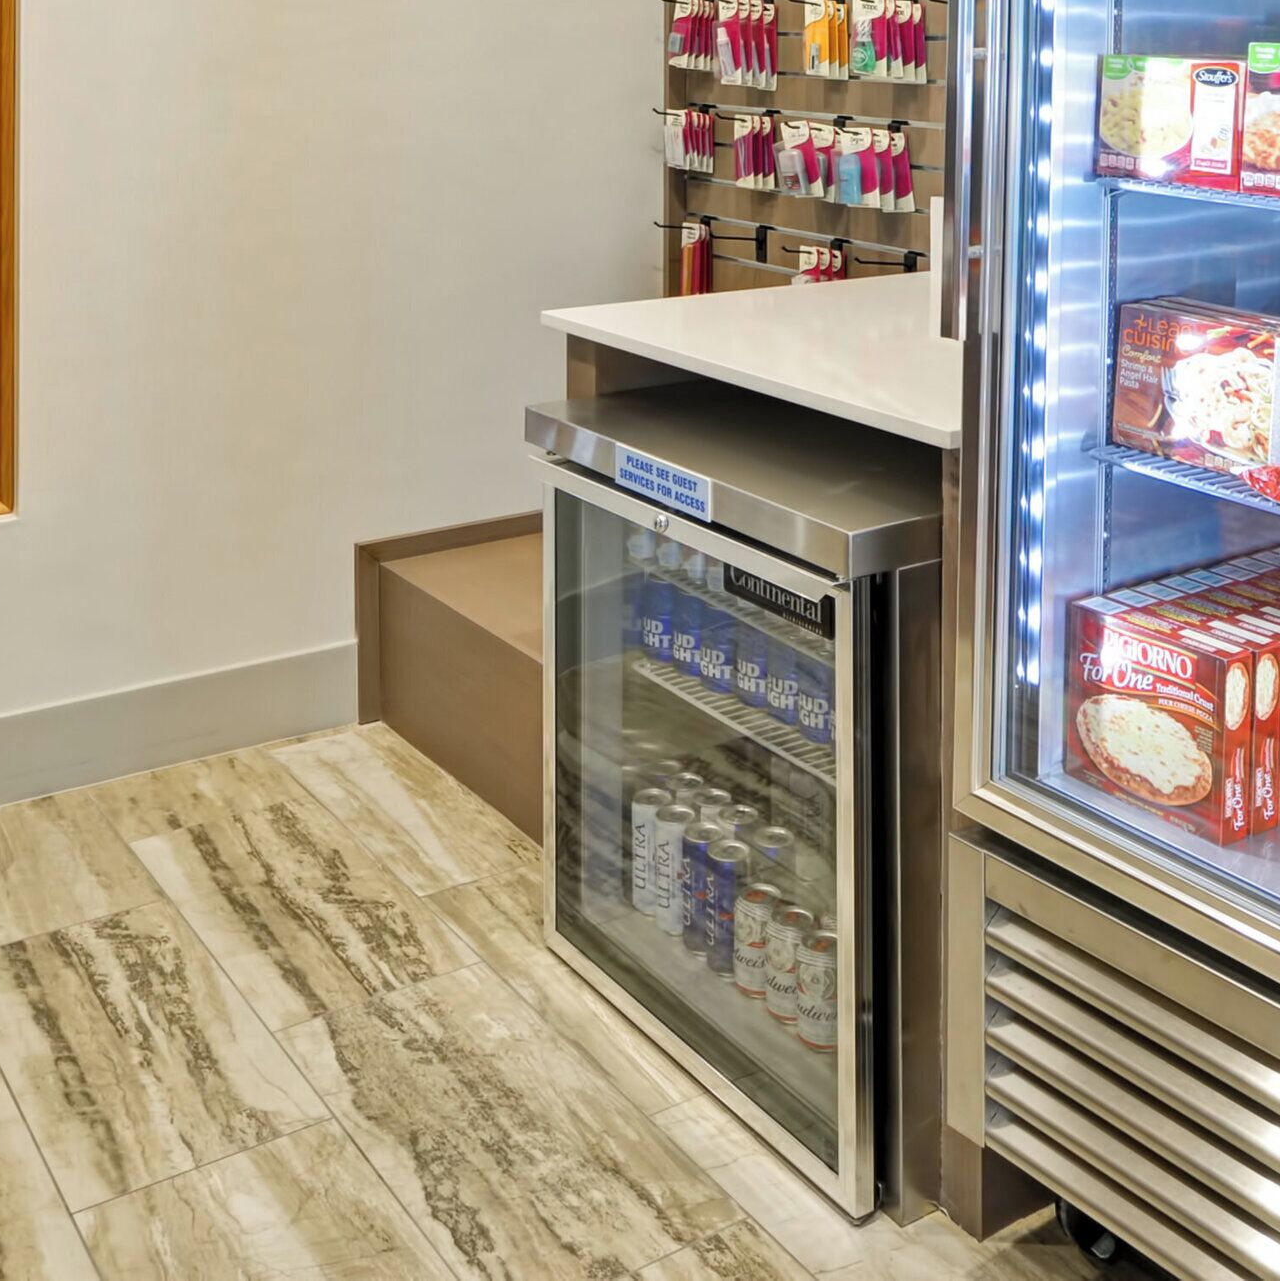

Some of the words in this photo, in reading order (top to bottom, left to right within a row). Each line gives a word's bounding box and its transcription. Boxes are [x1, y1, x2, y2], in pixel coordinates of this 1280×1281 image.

[1120, 369, 1141, 380] Angel
[626, 455, 654, 476] PLEASE
[655, 467, 670, 483] SEE
[672, 474, 698, 493] GUEST
[620, 467, 655, 491] SERVICES
[657, 483, 672, 498] FOR
[674, 491, 705, 513] ACCESS
[642, 617, 664, 634] UD
[674, 630, 696, 649] UD
[702, 646, 725, 665] UD
[737, 659, 761, 678] UD
[1112, 660, 1154, 691] One
[633, 822, 647, 891] ULTRA
[657, 840, 671, 909] ULTRA
